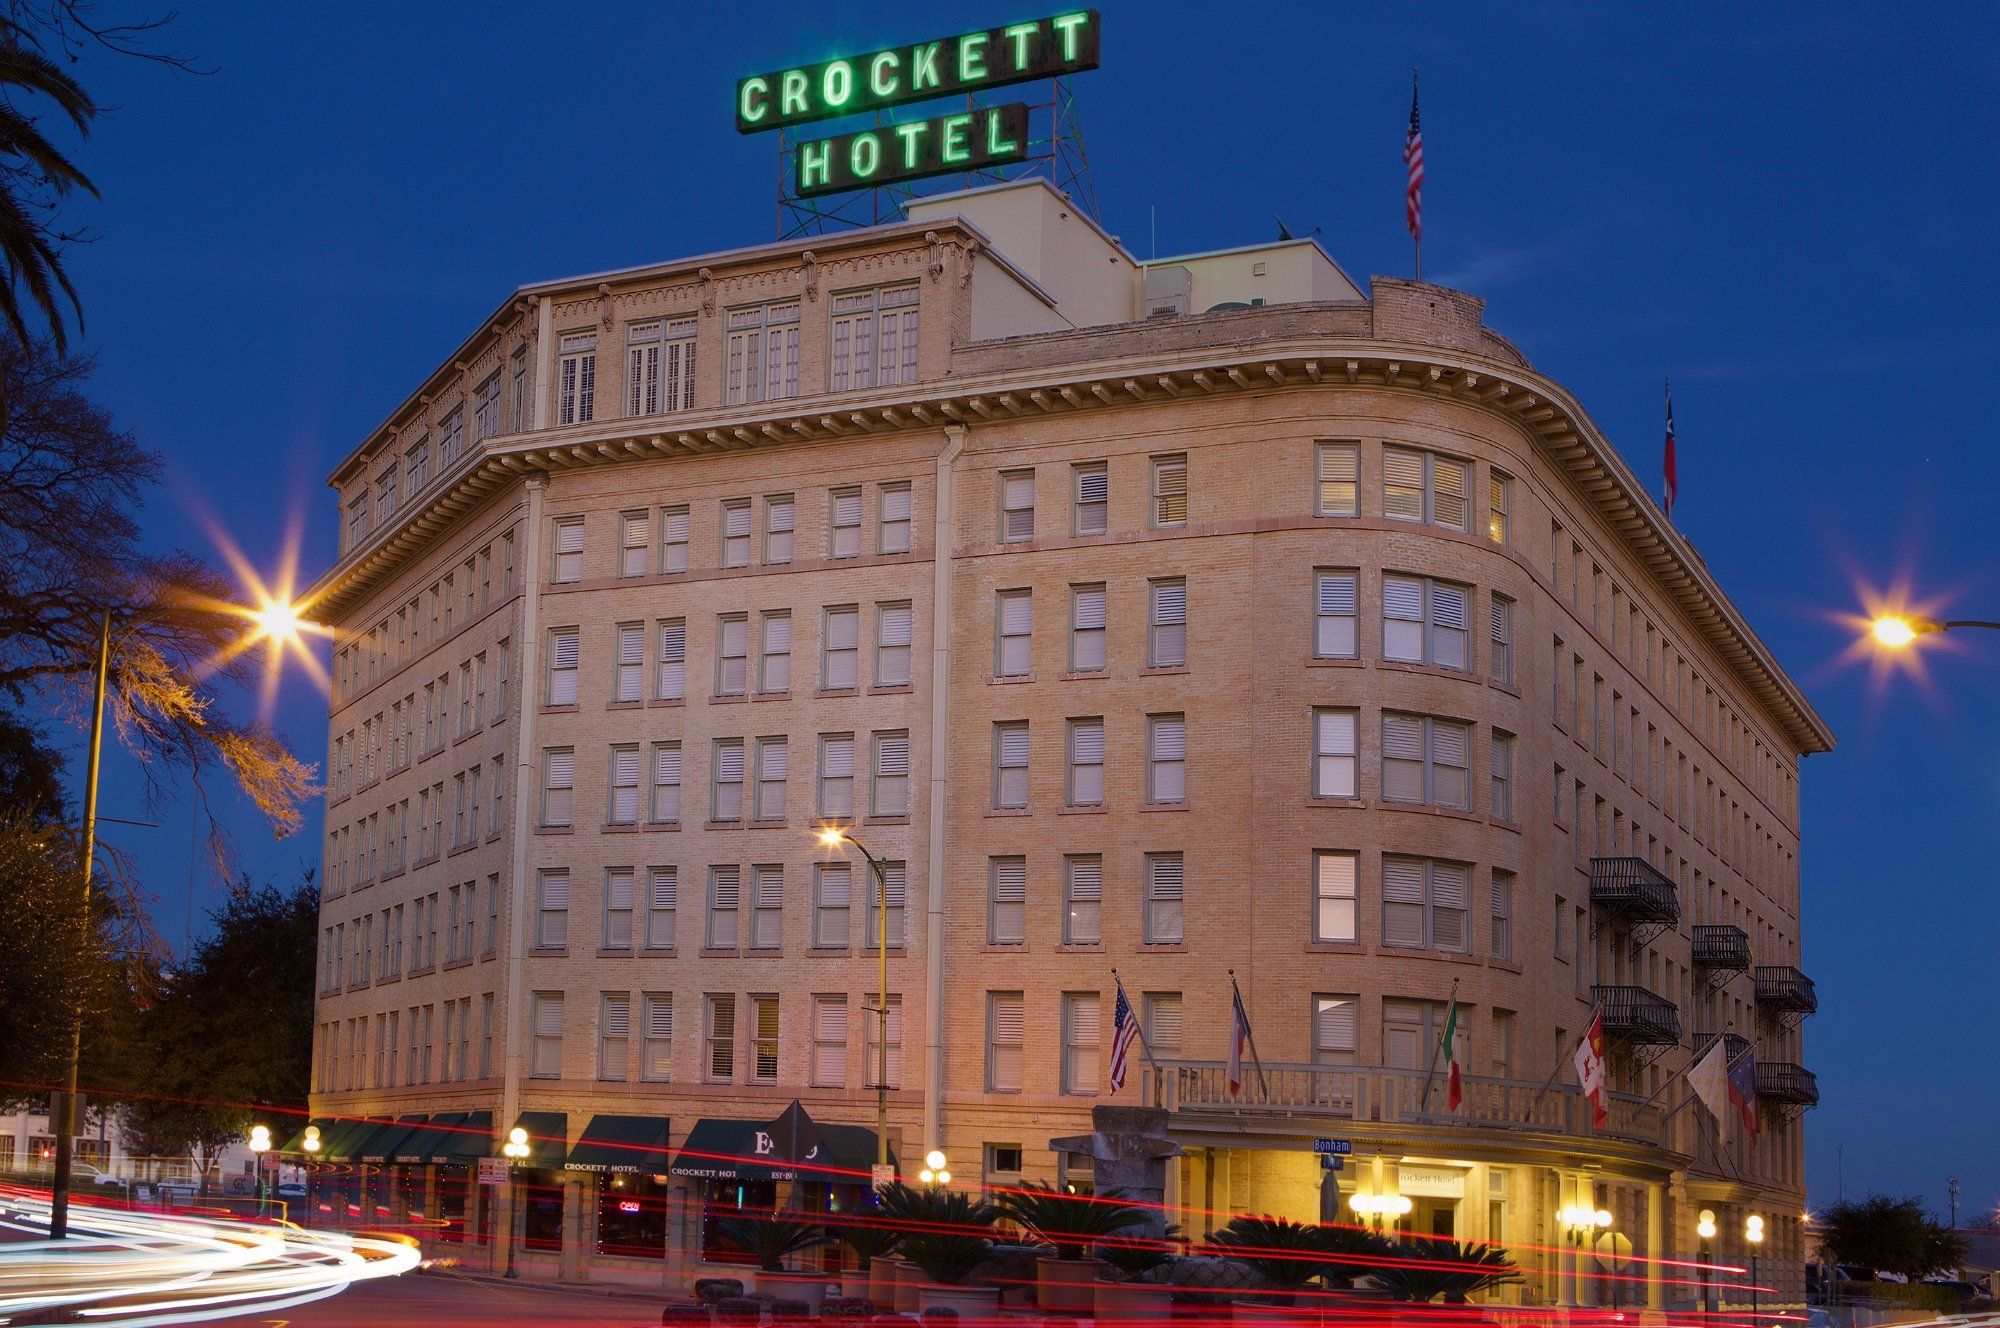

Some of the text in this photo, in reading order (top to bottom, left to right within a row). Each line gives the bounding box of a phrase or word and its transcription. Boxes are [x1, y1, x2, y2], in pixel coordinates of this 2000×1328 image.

[740, 12, 1089, 123] CROCKETT
[802, 108, 1017, 189] HOTEL
[1314, 1139, 1349, 1151] Bonham
[564, 1162, 640, 1173] CROCKETT HOTEL
[671, 1167, 717, 1177] CROCKETT
[1400, 1173, 1456, 1184] rockett Hotel
[620, 1201, 641, 1211] OPEN
